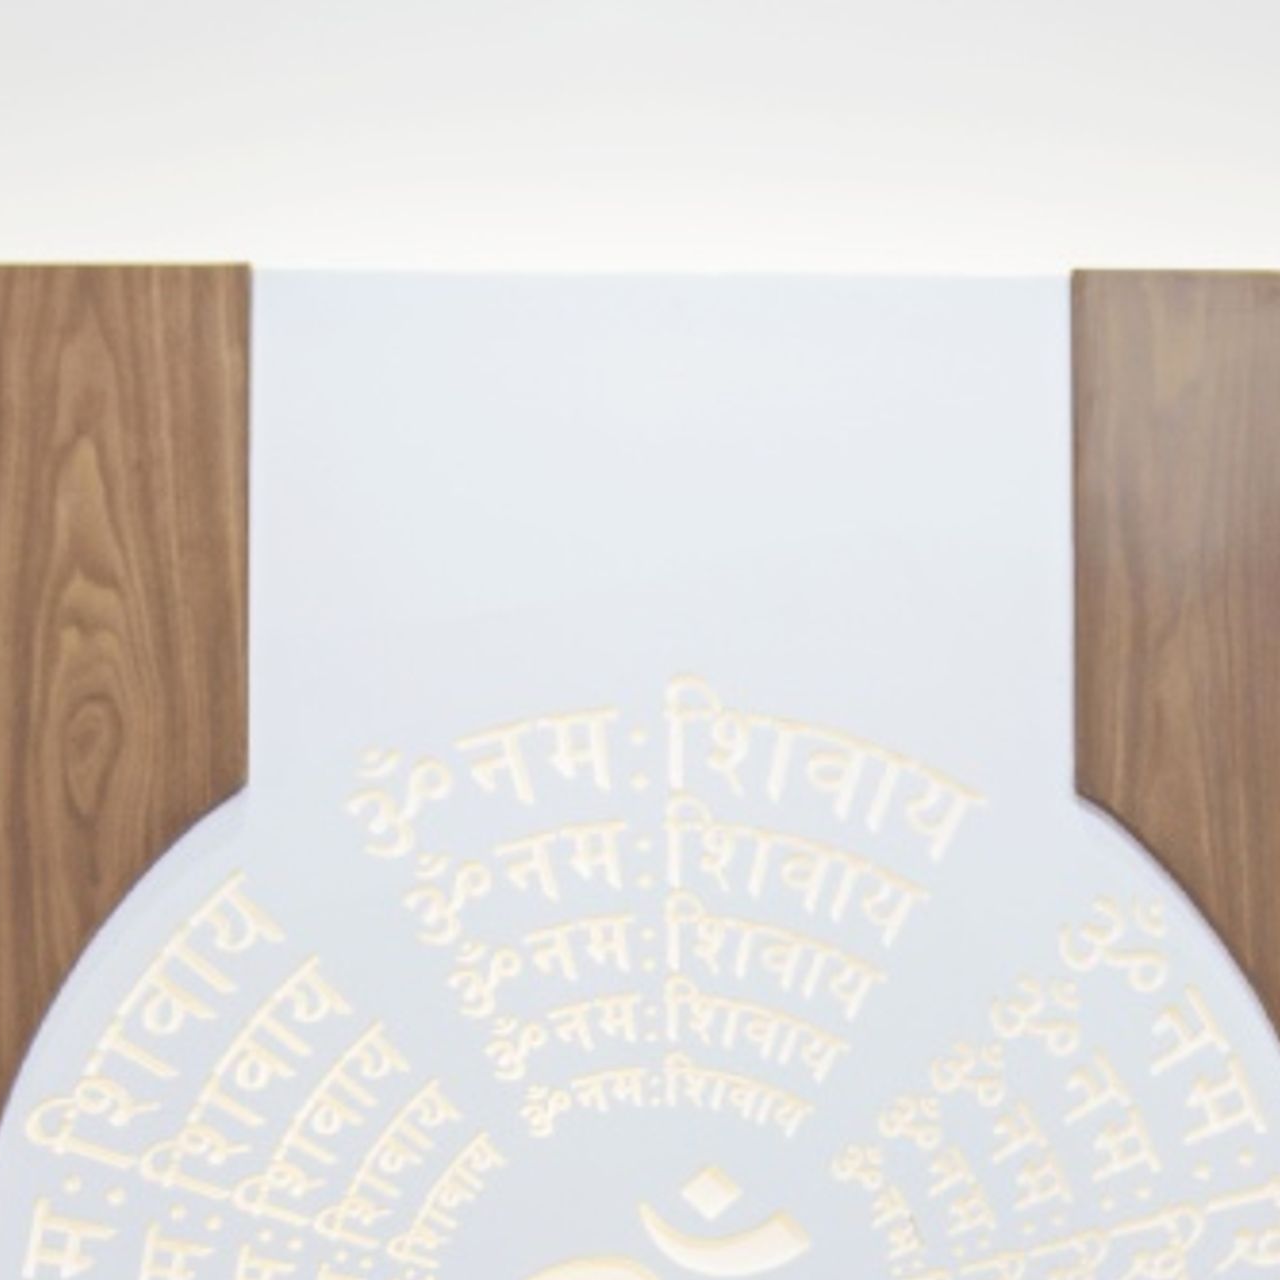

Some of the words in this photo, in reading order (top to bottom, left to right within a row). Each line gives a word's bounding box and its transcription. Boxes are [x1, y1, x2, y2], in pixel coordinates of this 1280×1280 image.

[663, 671, 989, 853] शिवाय
[663, 788, 934, 935] शिवाय
[664, 883, 887, 1012] शिवाय
[27, 867, 285, 1166] शिवाय
[127, 925, 350, 1199] शिवाय
[664, 970, 847, 1077] शिवाय
[231, 1001, 410, 1226] शिवाय
[316, 1076, 459, 1245] शिवाय
